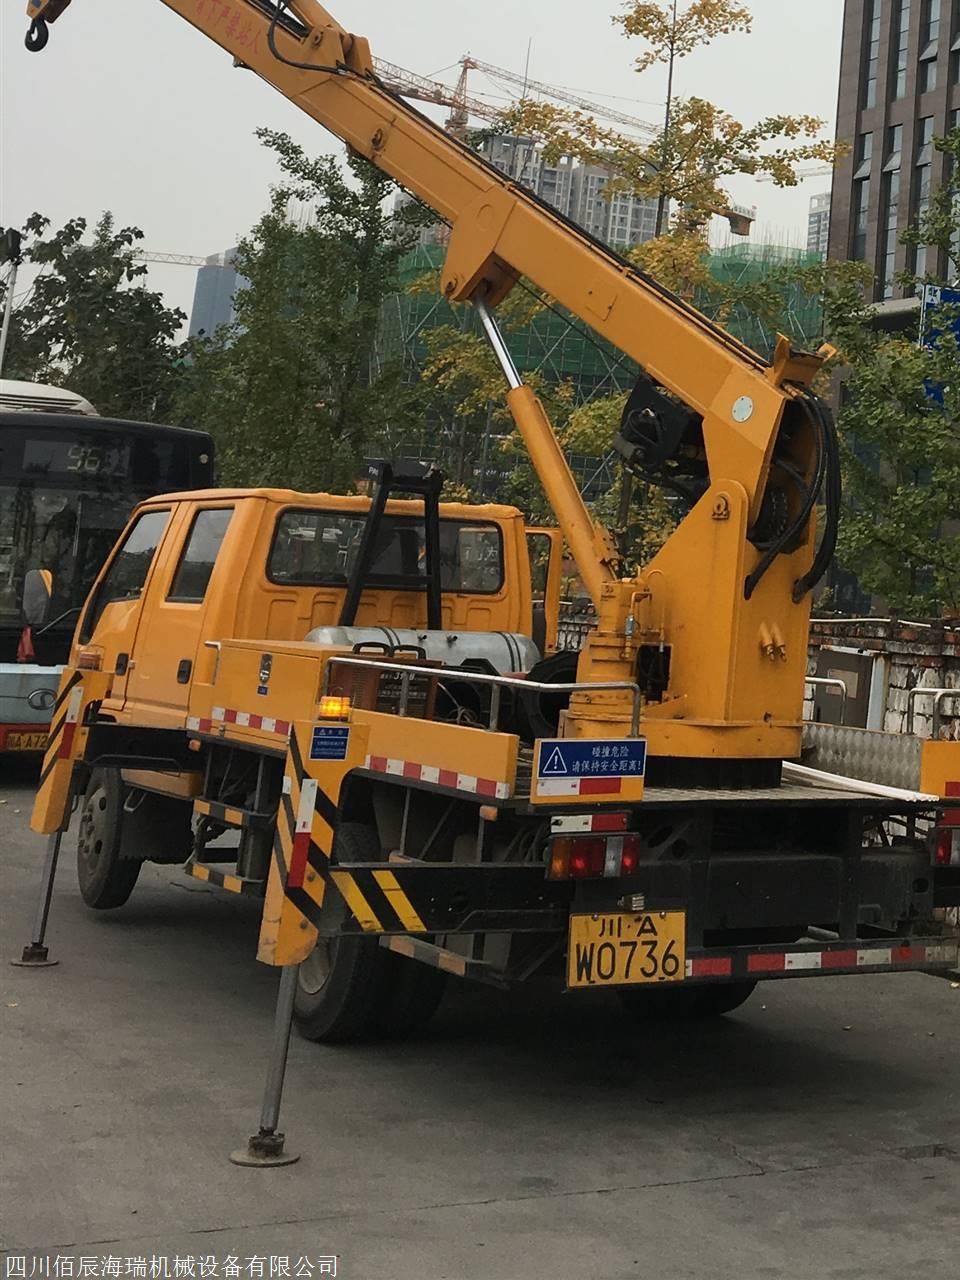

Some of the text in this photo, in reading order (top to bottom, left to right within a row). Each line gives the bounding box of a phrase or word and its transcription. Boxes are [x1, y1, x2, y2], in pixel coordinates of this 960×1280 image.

[592, 746, 630, 758] 碰撞危险
[576, 940, 680, 982] W0736
